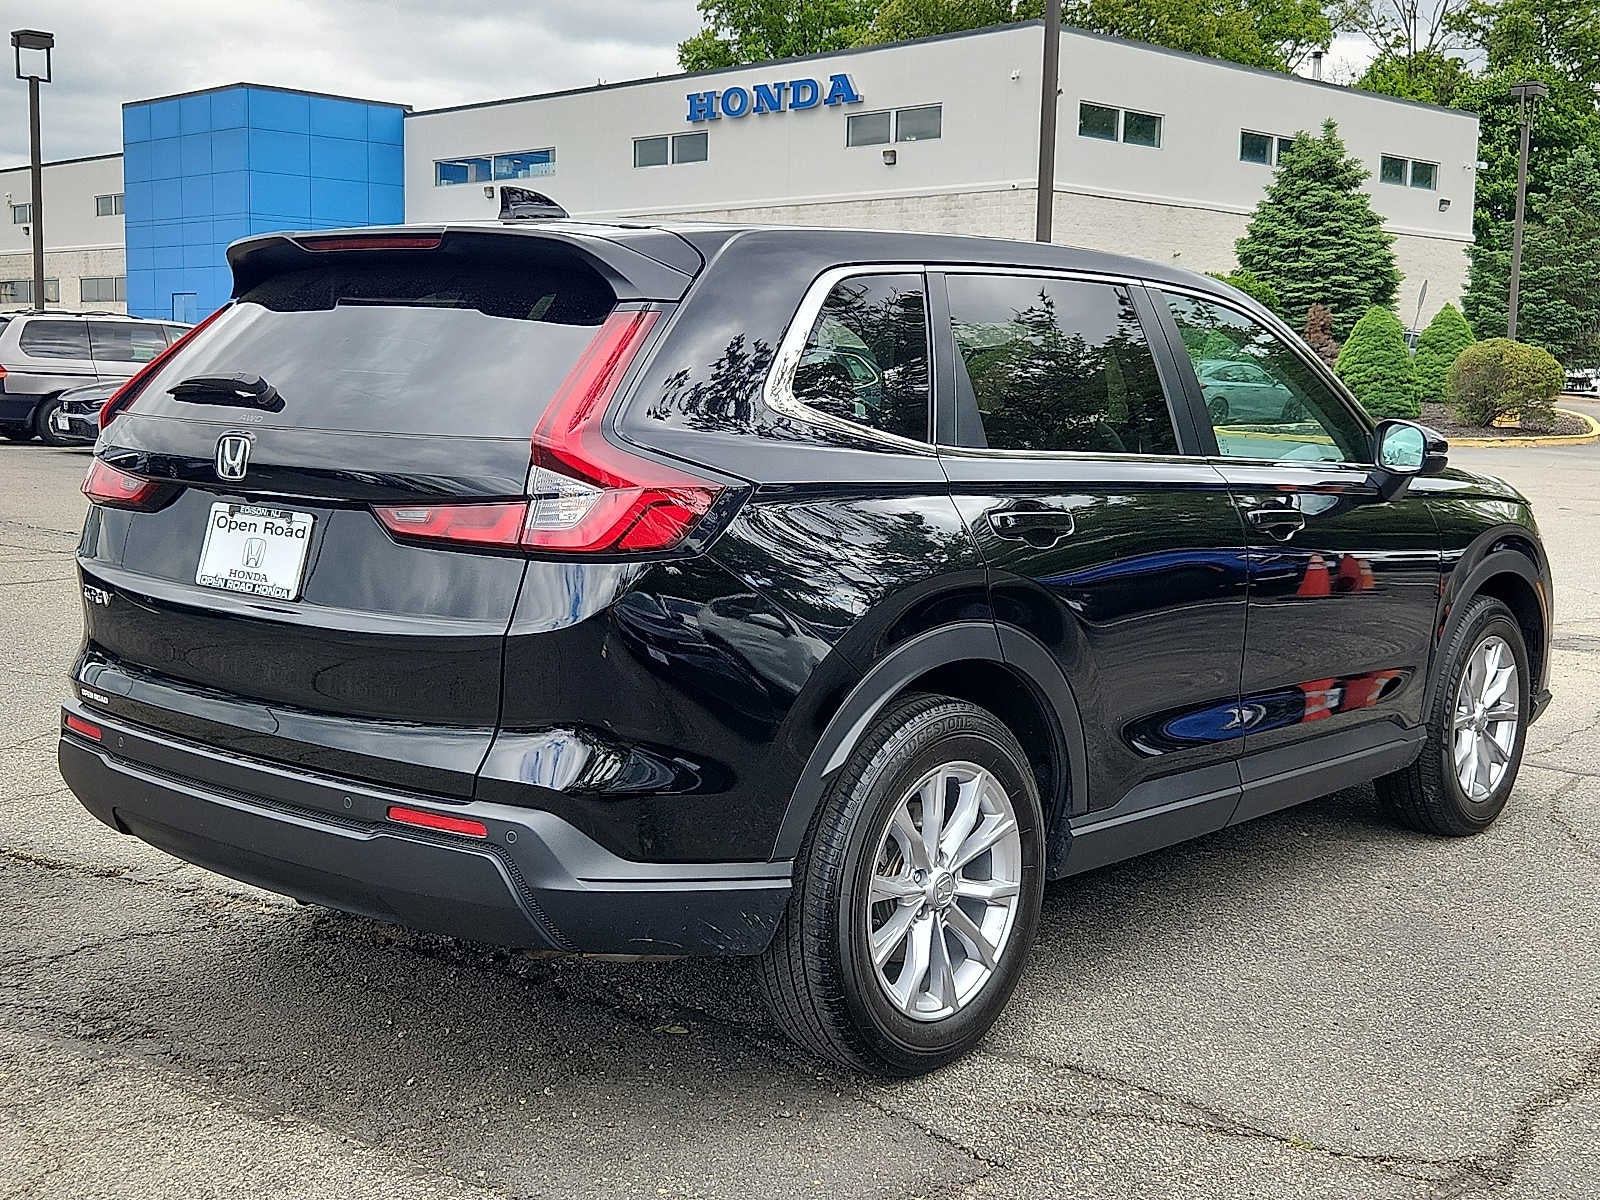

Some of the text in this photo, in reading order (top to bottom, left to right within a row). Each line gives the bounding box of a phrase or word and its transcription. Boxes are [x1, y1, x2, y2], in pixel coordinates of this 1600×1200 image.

[687, 73, 863, 123] HONDA
[240, 414, 263, 423] AWD
[271, 510, 281, 518] NJ
[217, 516, 306, 539] Open Road
[229, 569, 268, 582] HONDA
[200, 575, 289, 599] OPEN ROAD HONDA
[81, 687, 109, 704] OPEN ROAD
